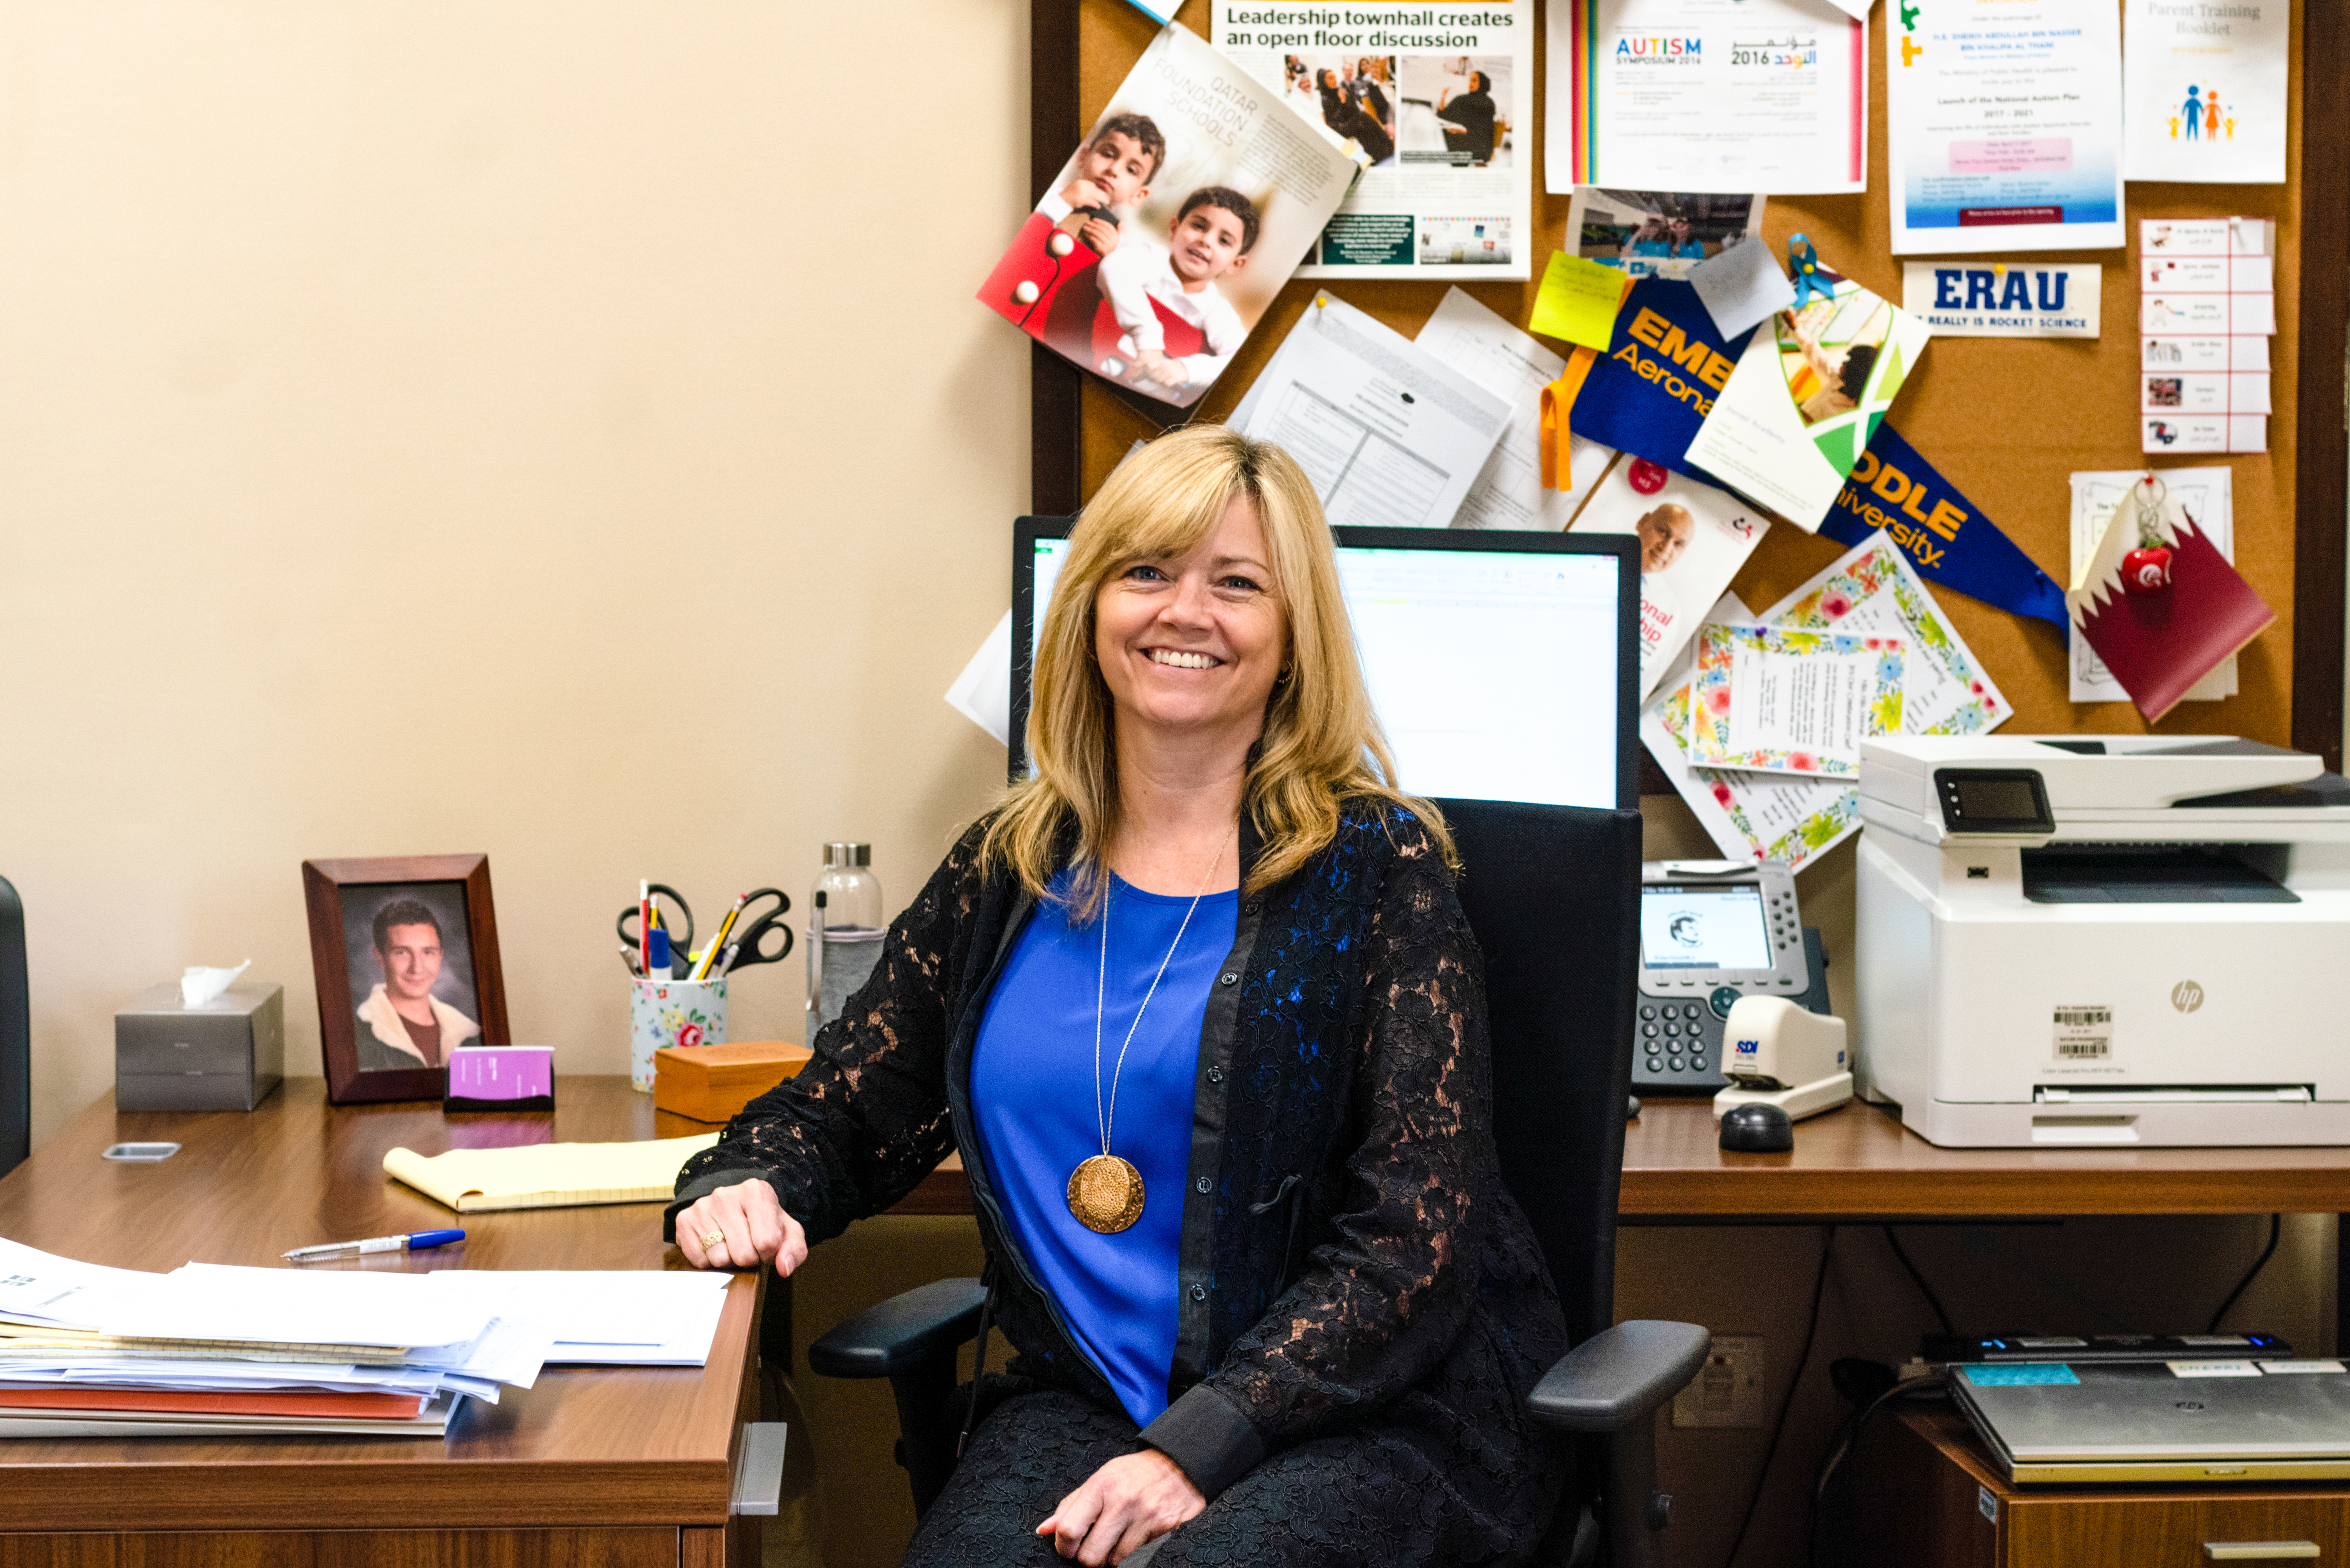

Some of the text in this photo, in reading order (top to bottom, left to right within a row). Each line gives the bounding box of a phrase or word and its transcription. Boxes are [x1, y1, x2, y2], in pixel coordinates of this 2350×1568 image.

[1228, 8, 1513, 28] Leadership townhall creates
[2148, 2, 2261, 21] Parent Training
[2176, 21, 2230, 35] Booklet
[1228, 30, 1478, 48] an open floor discussion
[1616, 38, 1702, 55] AUTISM
[1616, 57, 1676, 65] SYMPOSIUM
[1731, 50, 1817, 70] التوحد 2016
[1153, 58, 1248, 131] FOUNDATION
[1211, 76, 1259, 116] QATAR
[1938, 97, 1967, 105] Launch
[1995, 95, 2030, 103] National
[1165, 92, 1240, 148] SCHOOLS
[1934, 269, 2069, 311] ERAU
[1928, 316, 1968, 326] REALLY
[1973, 317, 1984, 326] IS
[1989, 317, 2033, 327] ROCKET
[2040, 318, 2087, 328] SCIENCE
